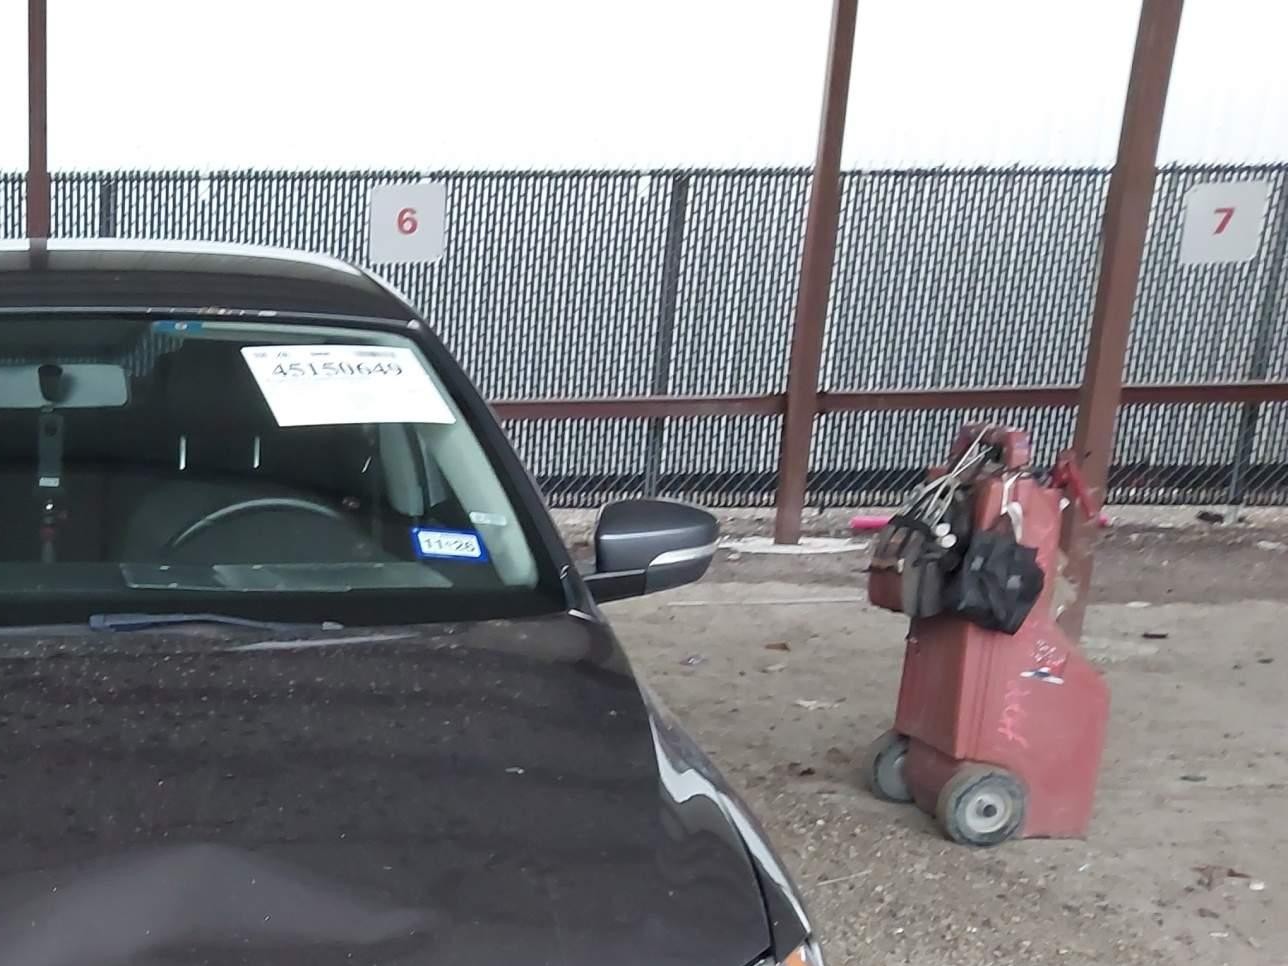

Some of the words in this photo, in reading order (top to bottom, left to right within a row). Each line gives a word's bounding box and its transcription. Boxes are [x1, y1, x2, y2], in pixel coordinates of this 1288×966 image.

[397, 207, 418, 235] 6
[1213, 206, 1235, 235] 7
[272, 361, 403, 376] 45150649
